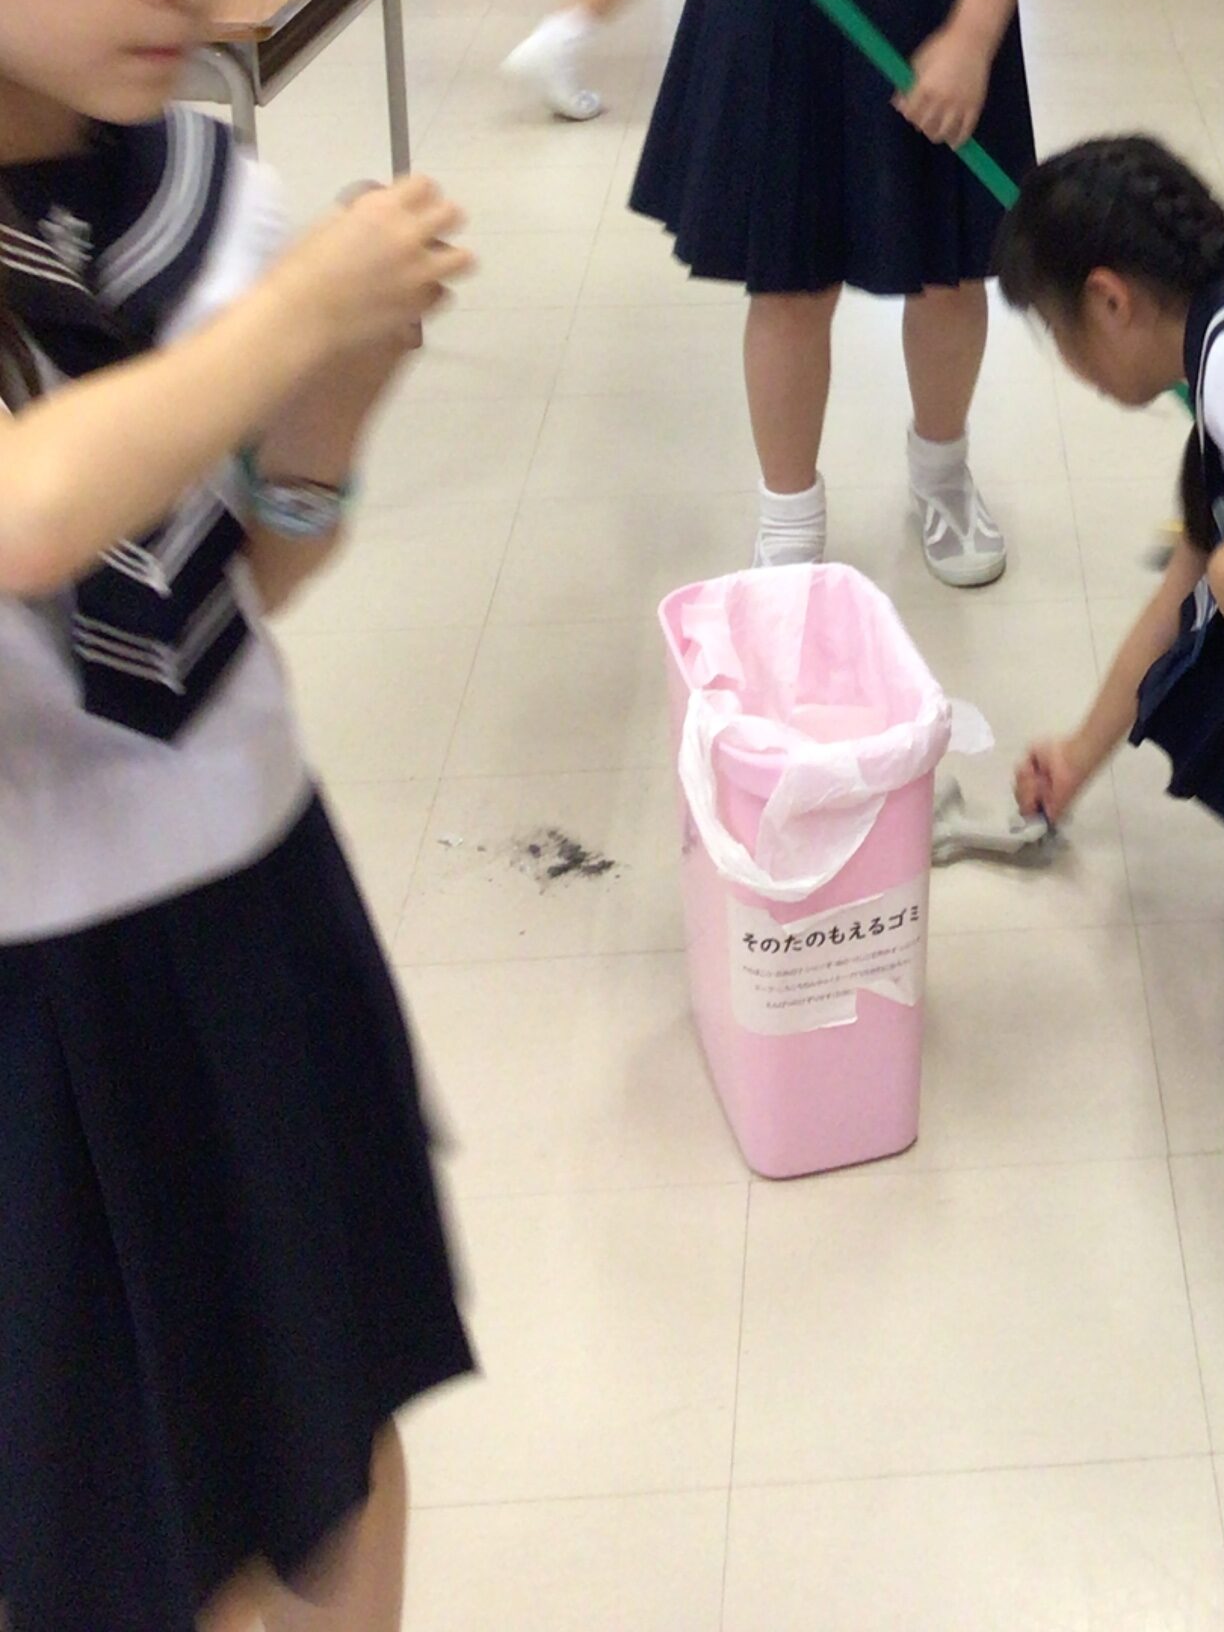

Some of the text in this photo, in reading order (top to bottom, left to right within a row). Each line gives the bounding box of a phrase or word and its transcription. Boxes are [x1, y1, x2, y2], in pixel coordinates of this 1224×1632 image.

[742, 905, 919, 954] そのたのもえるゴミ
